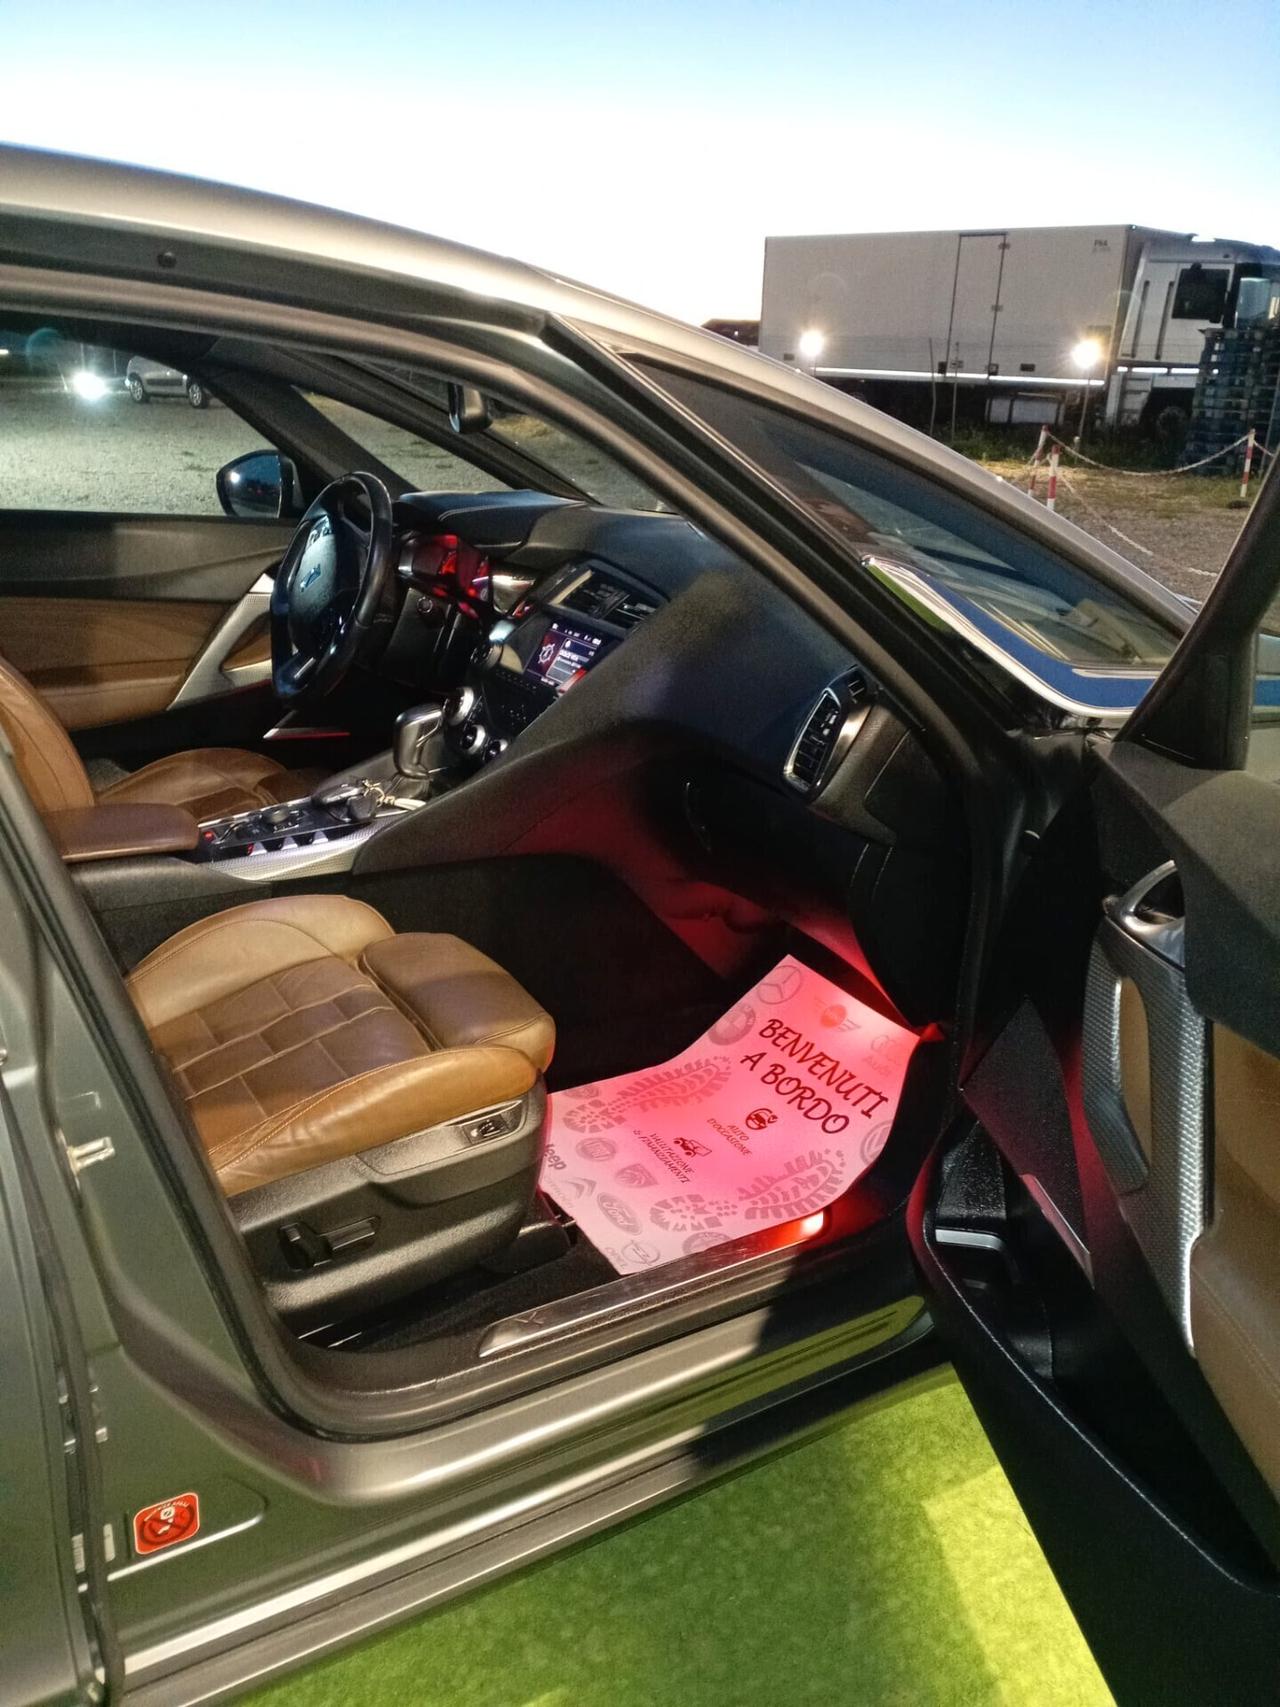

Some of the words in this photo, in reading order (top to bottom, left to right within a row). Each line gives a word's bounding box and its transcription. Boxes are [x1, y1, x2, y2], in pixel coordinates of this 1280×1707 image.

[740, 1051, 767, 1072] A
[760, 1063, 850, 1134] BORDO
[758, 1018, 889, 1119] BENVENUTI
[649, 1132, 695, 1174] VALUTAZIONE
[727, 1124, 750, 1141] AUTO
[638, 1136, 690, 1184] FINANZIAMENTI
